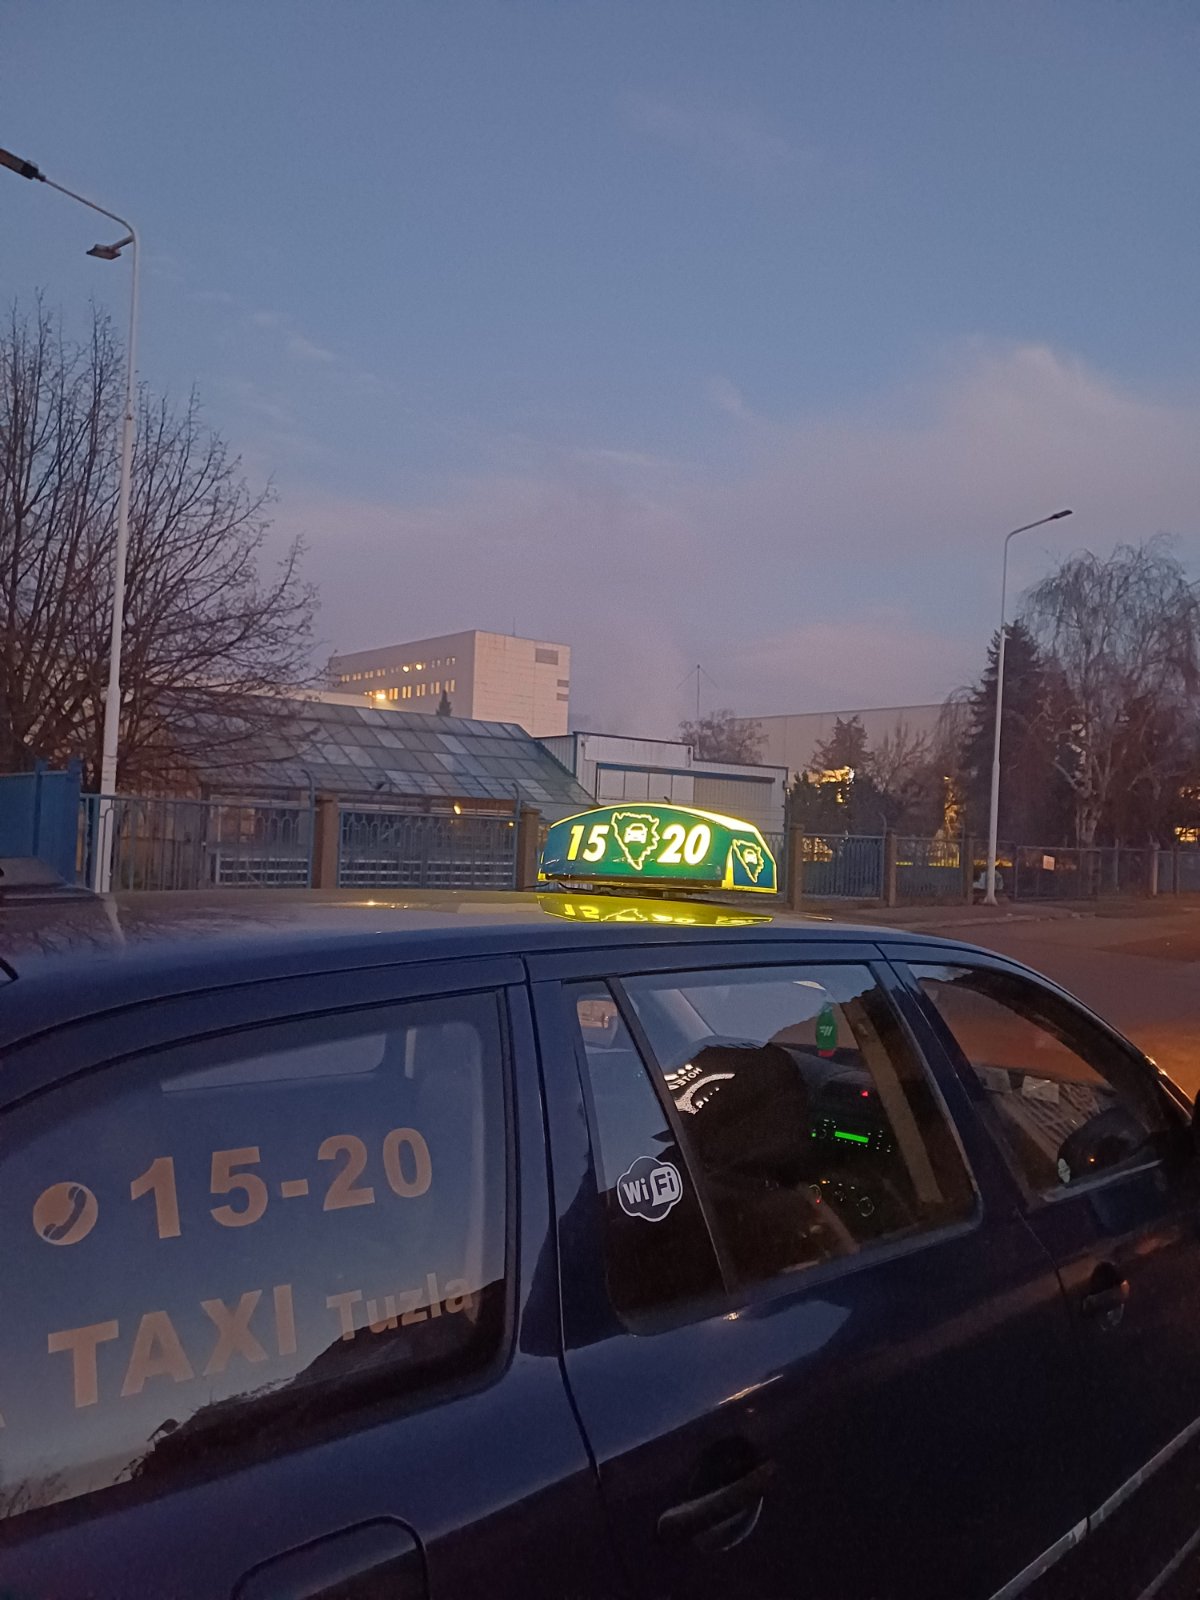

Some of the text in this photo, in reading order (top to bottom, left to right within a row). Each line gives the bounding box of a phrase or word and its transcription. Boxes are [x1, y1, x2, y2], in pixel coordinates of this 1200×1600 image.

[567, 824, 711, 865] 15 20
[130, 1127, 433, 1239] 15-20
[622, 1170, 677, 1205] WiFi
[48, 1272, 474, 1408] TAXI Tuzla
